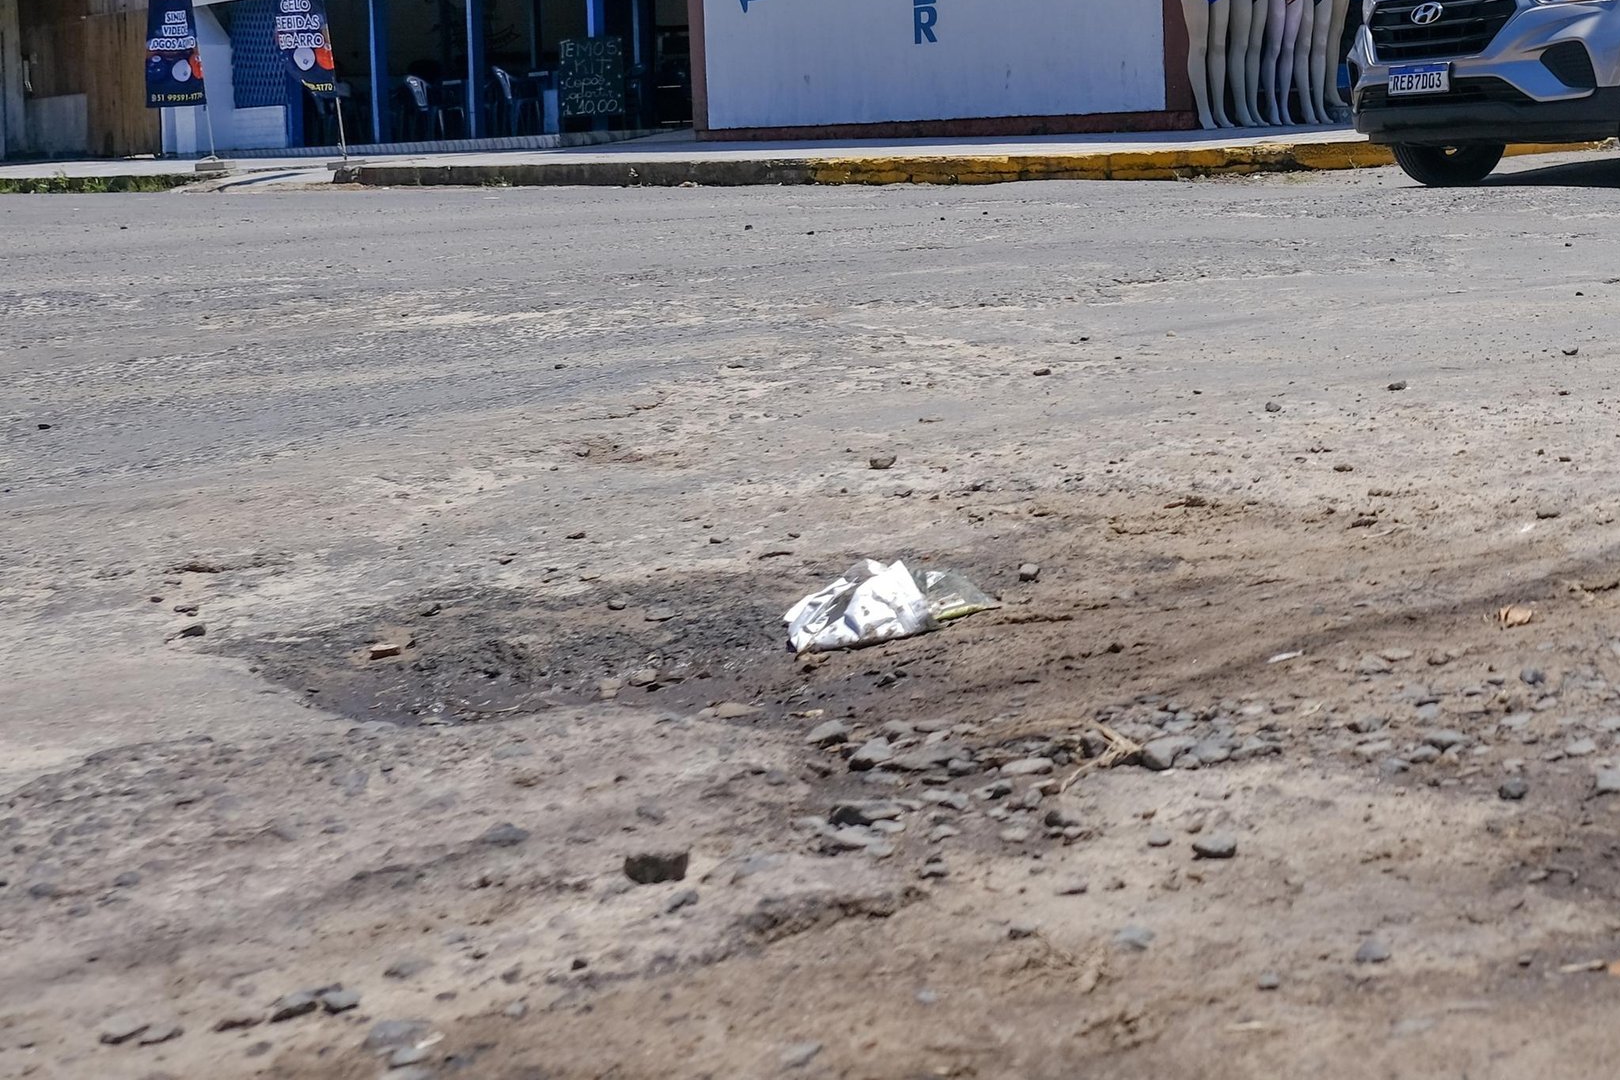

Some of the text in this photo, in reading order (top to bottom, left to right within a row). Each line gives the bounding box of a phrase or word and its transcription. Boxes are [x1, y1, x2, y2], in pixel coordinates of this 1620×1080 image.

[560, 39, 617, 58] TEMOS
[575, 58, 613, 74] KIT
[1393, 72, 1442, 91] REB7D03
